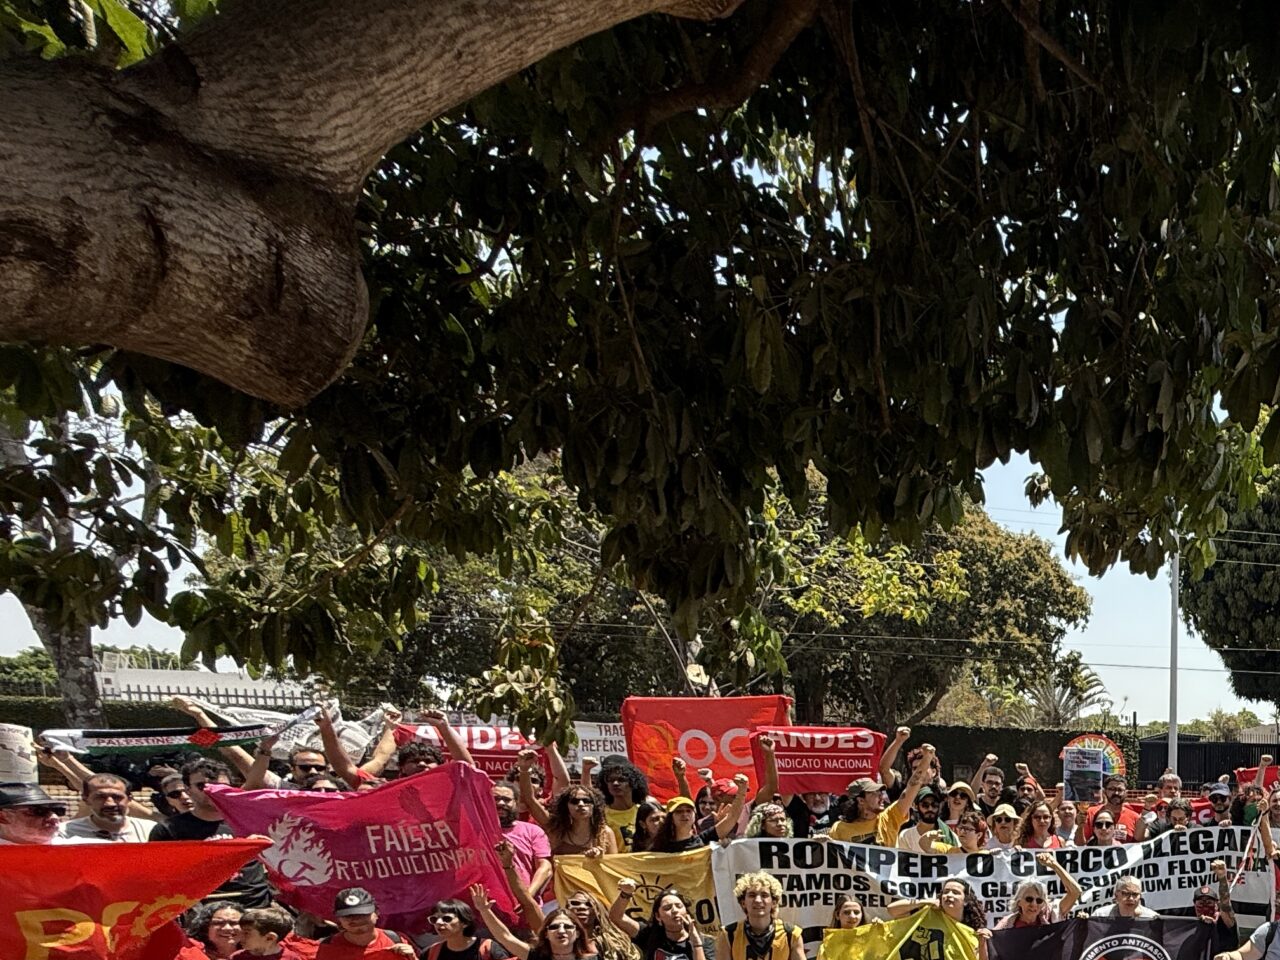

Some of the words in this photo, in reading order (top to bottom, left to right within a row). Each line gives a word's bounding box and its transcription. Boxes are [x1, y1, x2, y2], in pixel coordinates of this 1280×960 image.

[97, 736, 174, 746] PALESTINE
[774, 757, 820, 768] INDICATO
[824, 758, 873, 769] NACIONAL
[758, 841, 949, 878] ROMPER
[966, 853, 994, 877] O
[765, 873, 871, 892] TAMOS
[777, 892, 839, 908] OMPER
